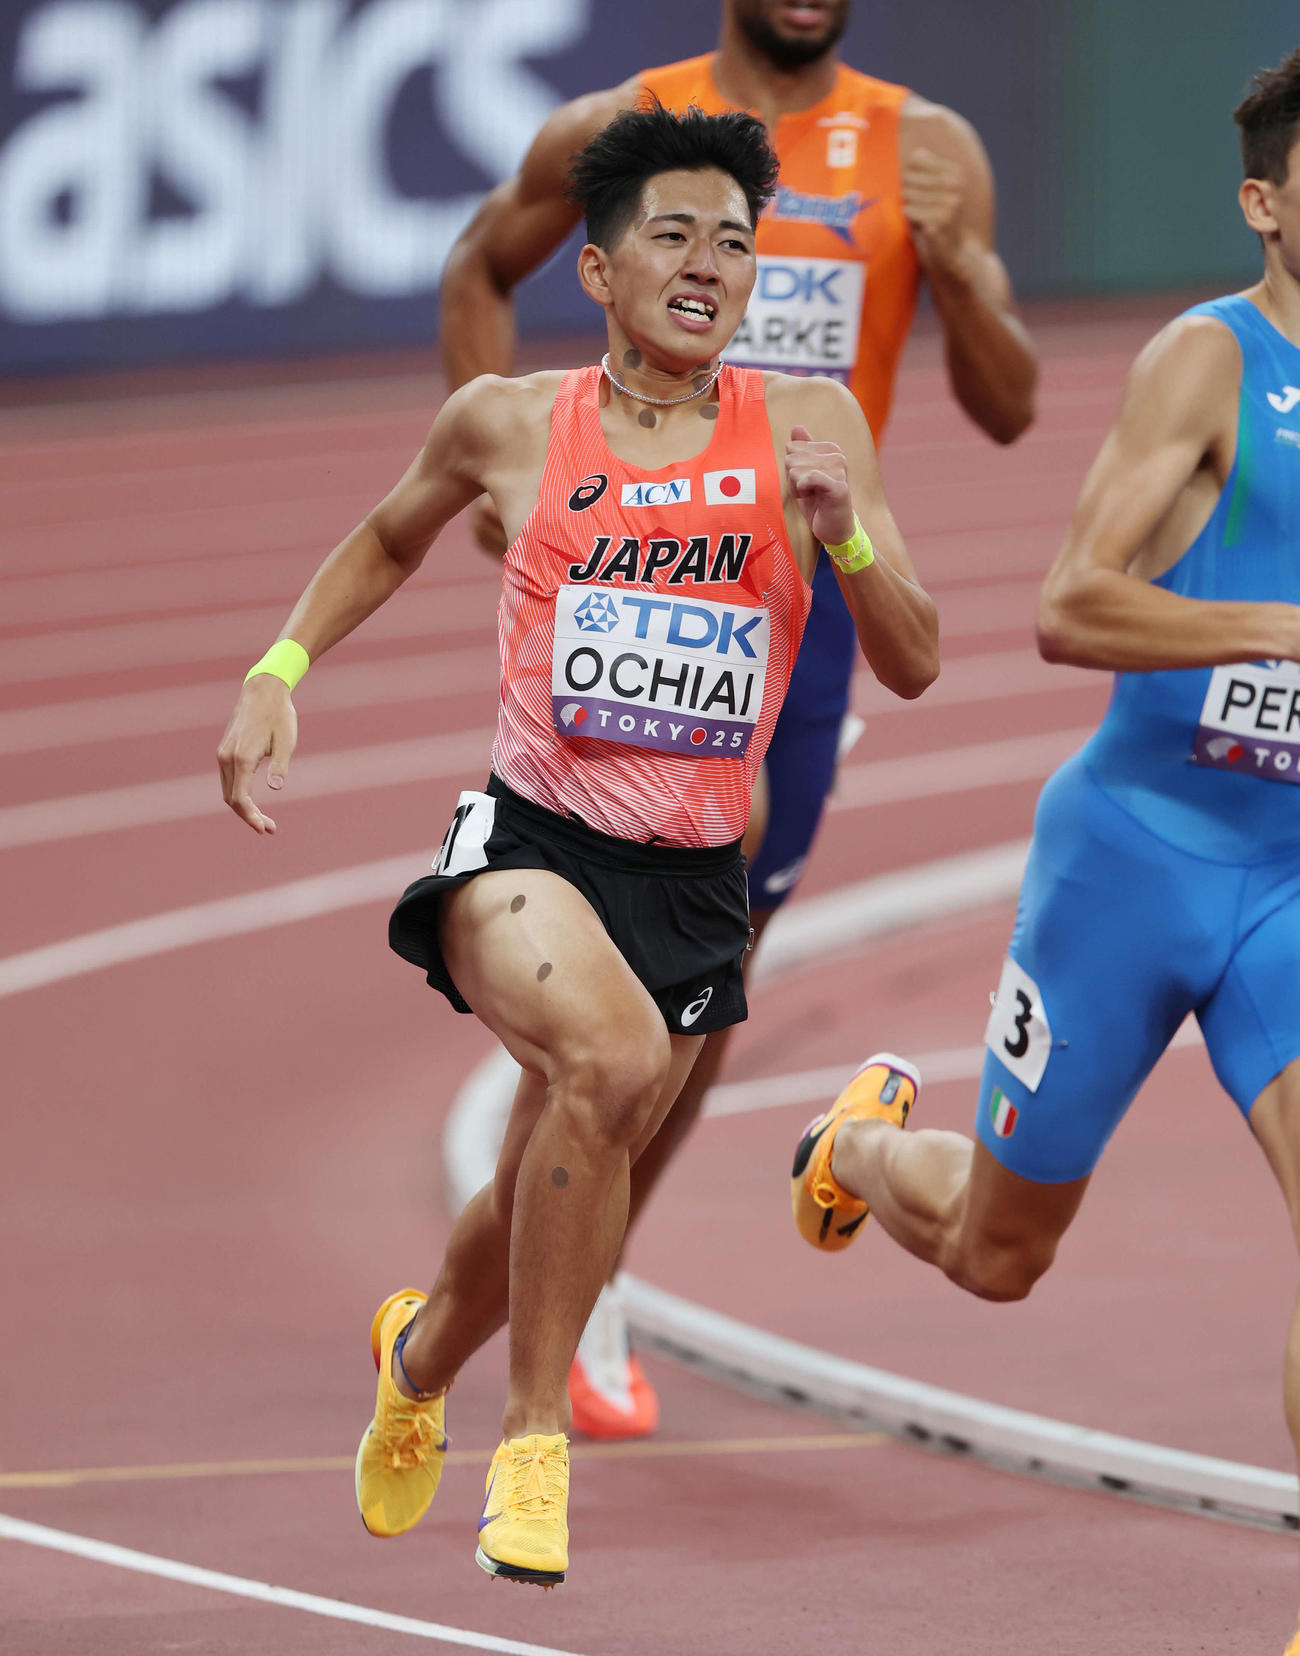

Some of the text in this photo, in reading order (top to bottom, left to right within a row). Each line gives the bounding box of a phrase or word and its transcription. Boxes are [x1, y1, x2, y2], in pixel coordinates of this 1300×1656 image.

[757, 266, 845, 304] DK
[725, 316, 844, 360] ARKE
[625, 481, 687, 504] ACN
[568, 533, 753, 585] JAPAN
[622, 596, 763, 658] TDK
[565, 646, 754, 716] OCHIAI
[1255, 747, 1300, 773] TO
[1004, 989, 1032, 1058] 3
